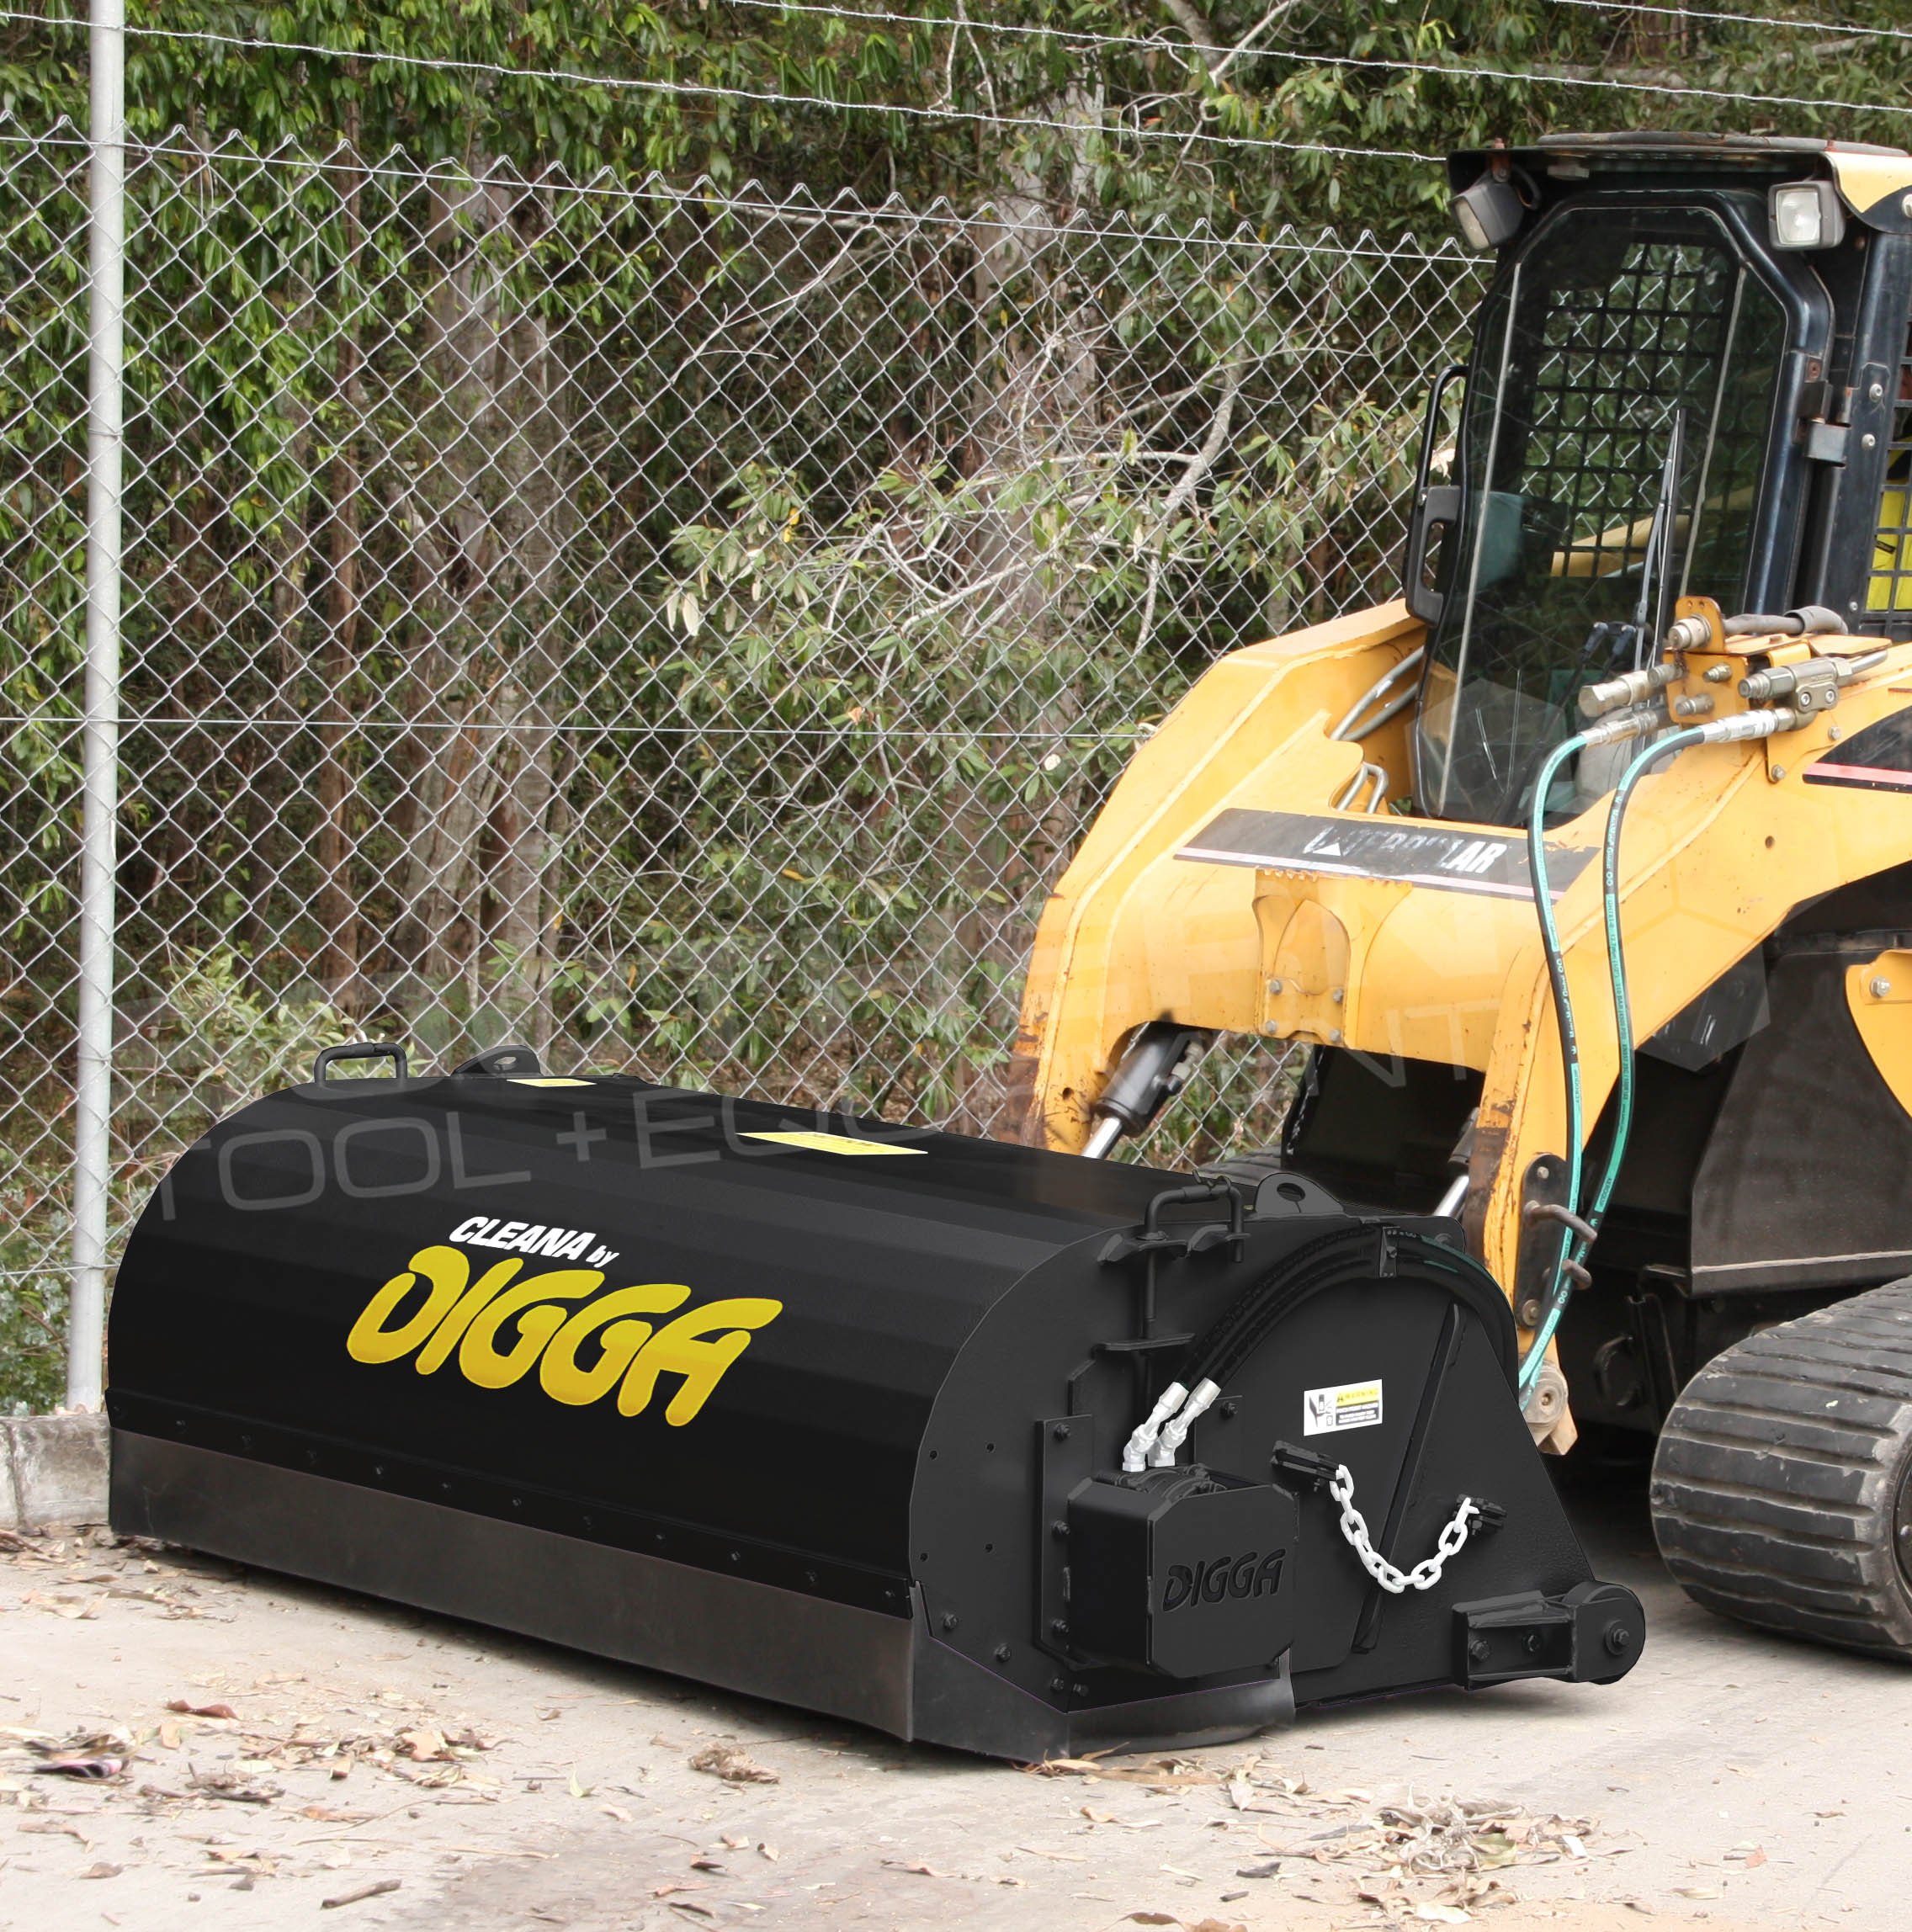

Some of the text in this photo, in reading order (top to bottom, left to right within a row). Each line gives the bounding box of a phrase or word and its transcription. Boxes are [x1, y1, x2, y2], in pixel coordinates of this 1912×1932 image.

[449, 1217, 619, 1267] CLEANA by
[347, 1245, 783, 1426] DIGGA
[1164, 1549, 1286, 1611] DIGGA
